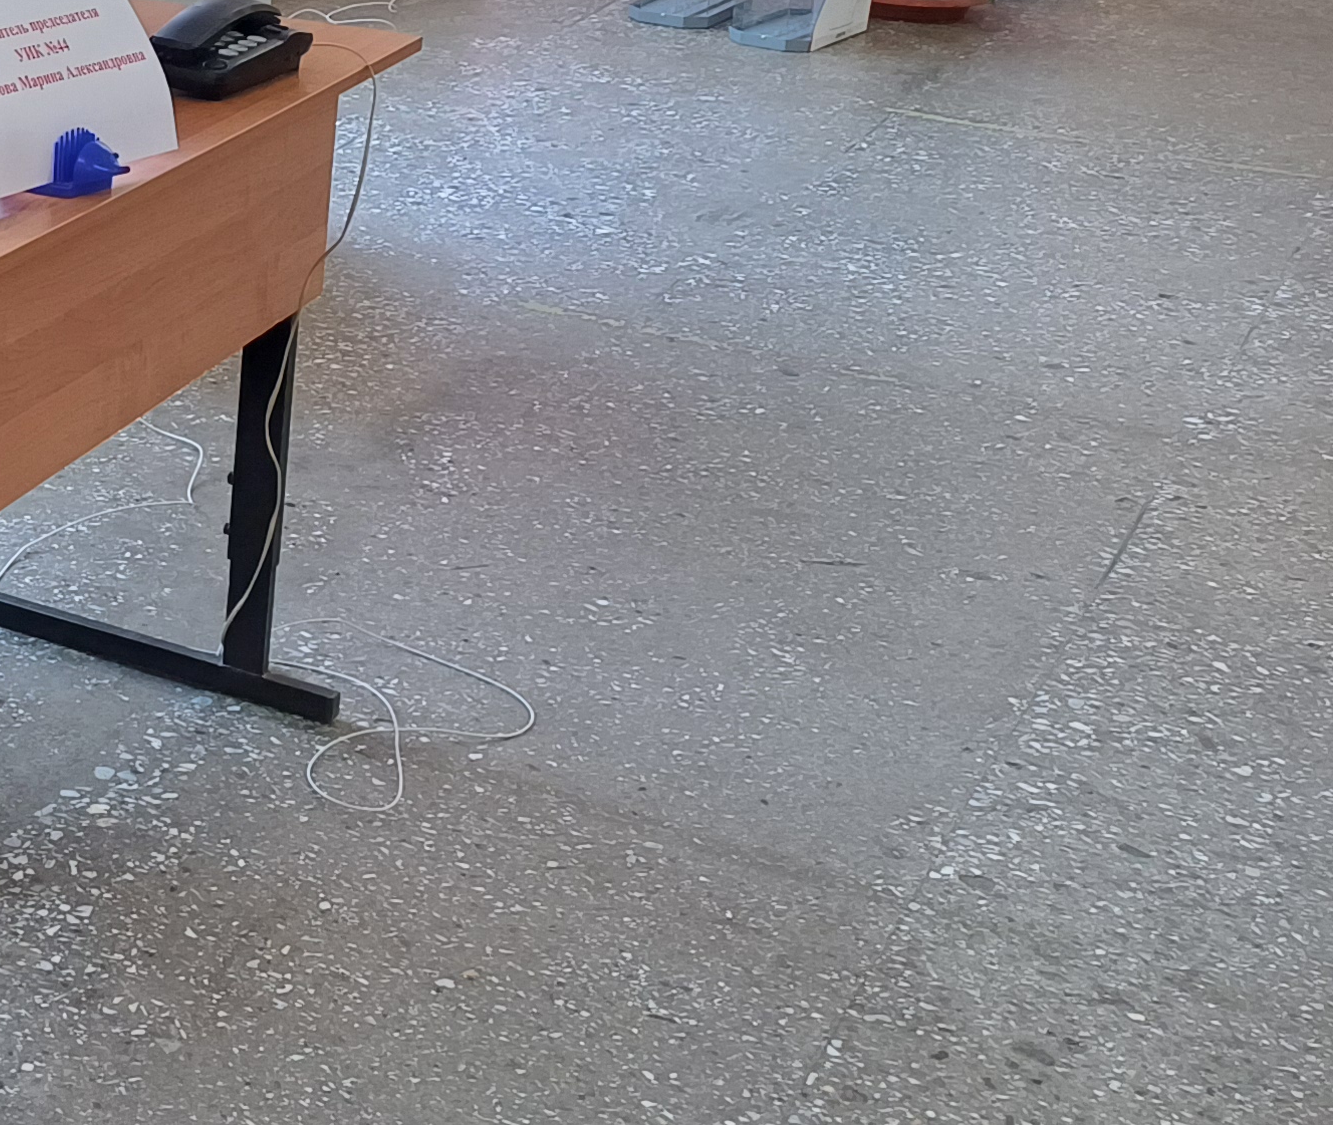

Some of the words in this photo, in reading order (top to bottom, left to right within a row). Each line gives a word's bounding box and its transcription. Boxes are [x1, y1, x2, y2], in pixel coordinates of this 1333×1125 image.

[30, 8, 99, 34] председателя
[14, 44, 44, 63] УИК
[19, 69, 64, 93] Марина
[65, 50, 147, 81] Александровна
